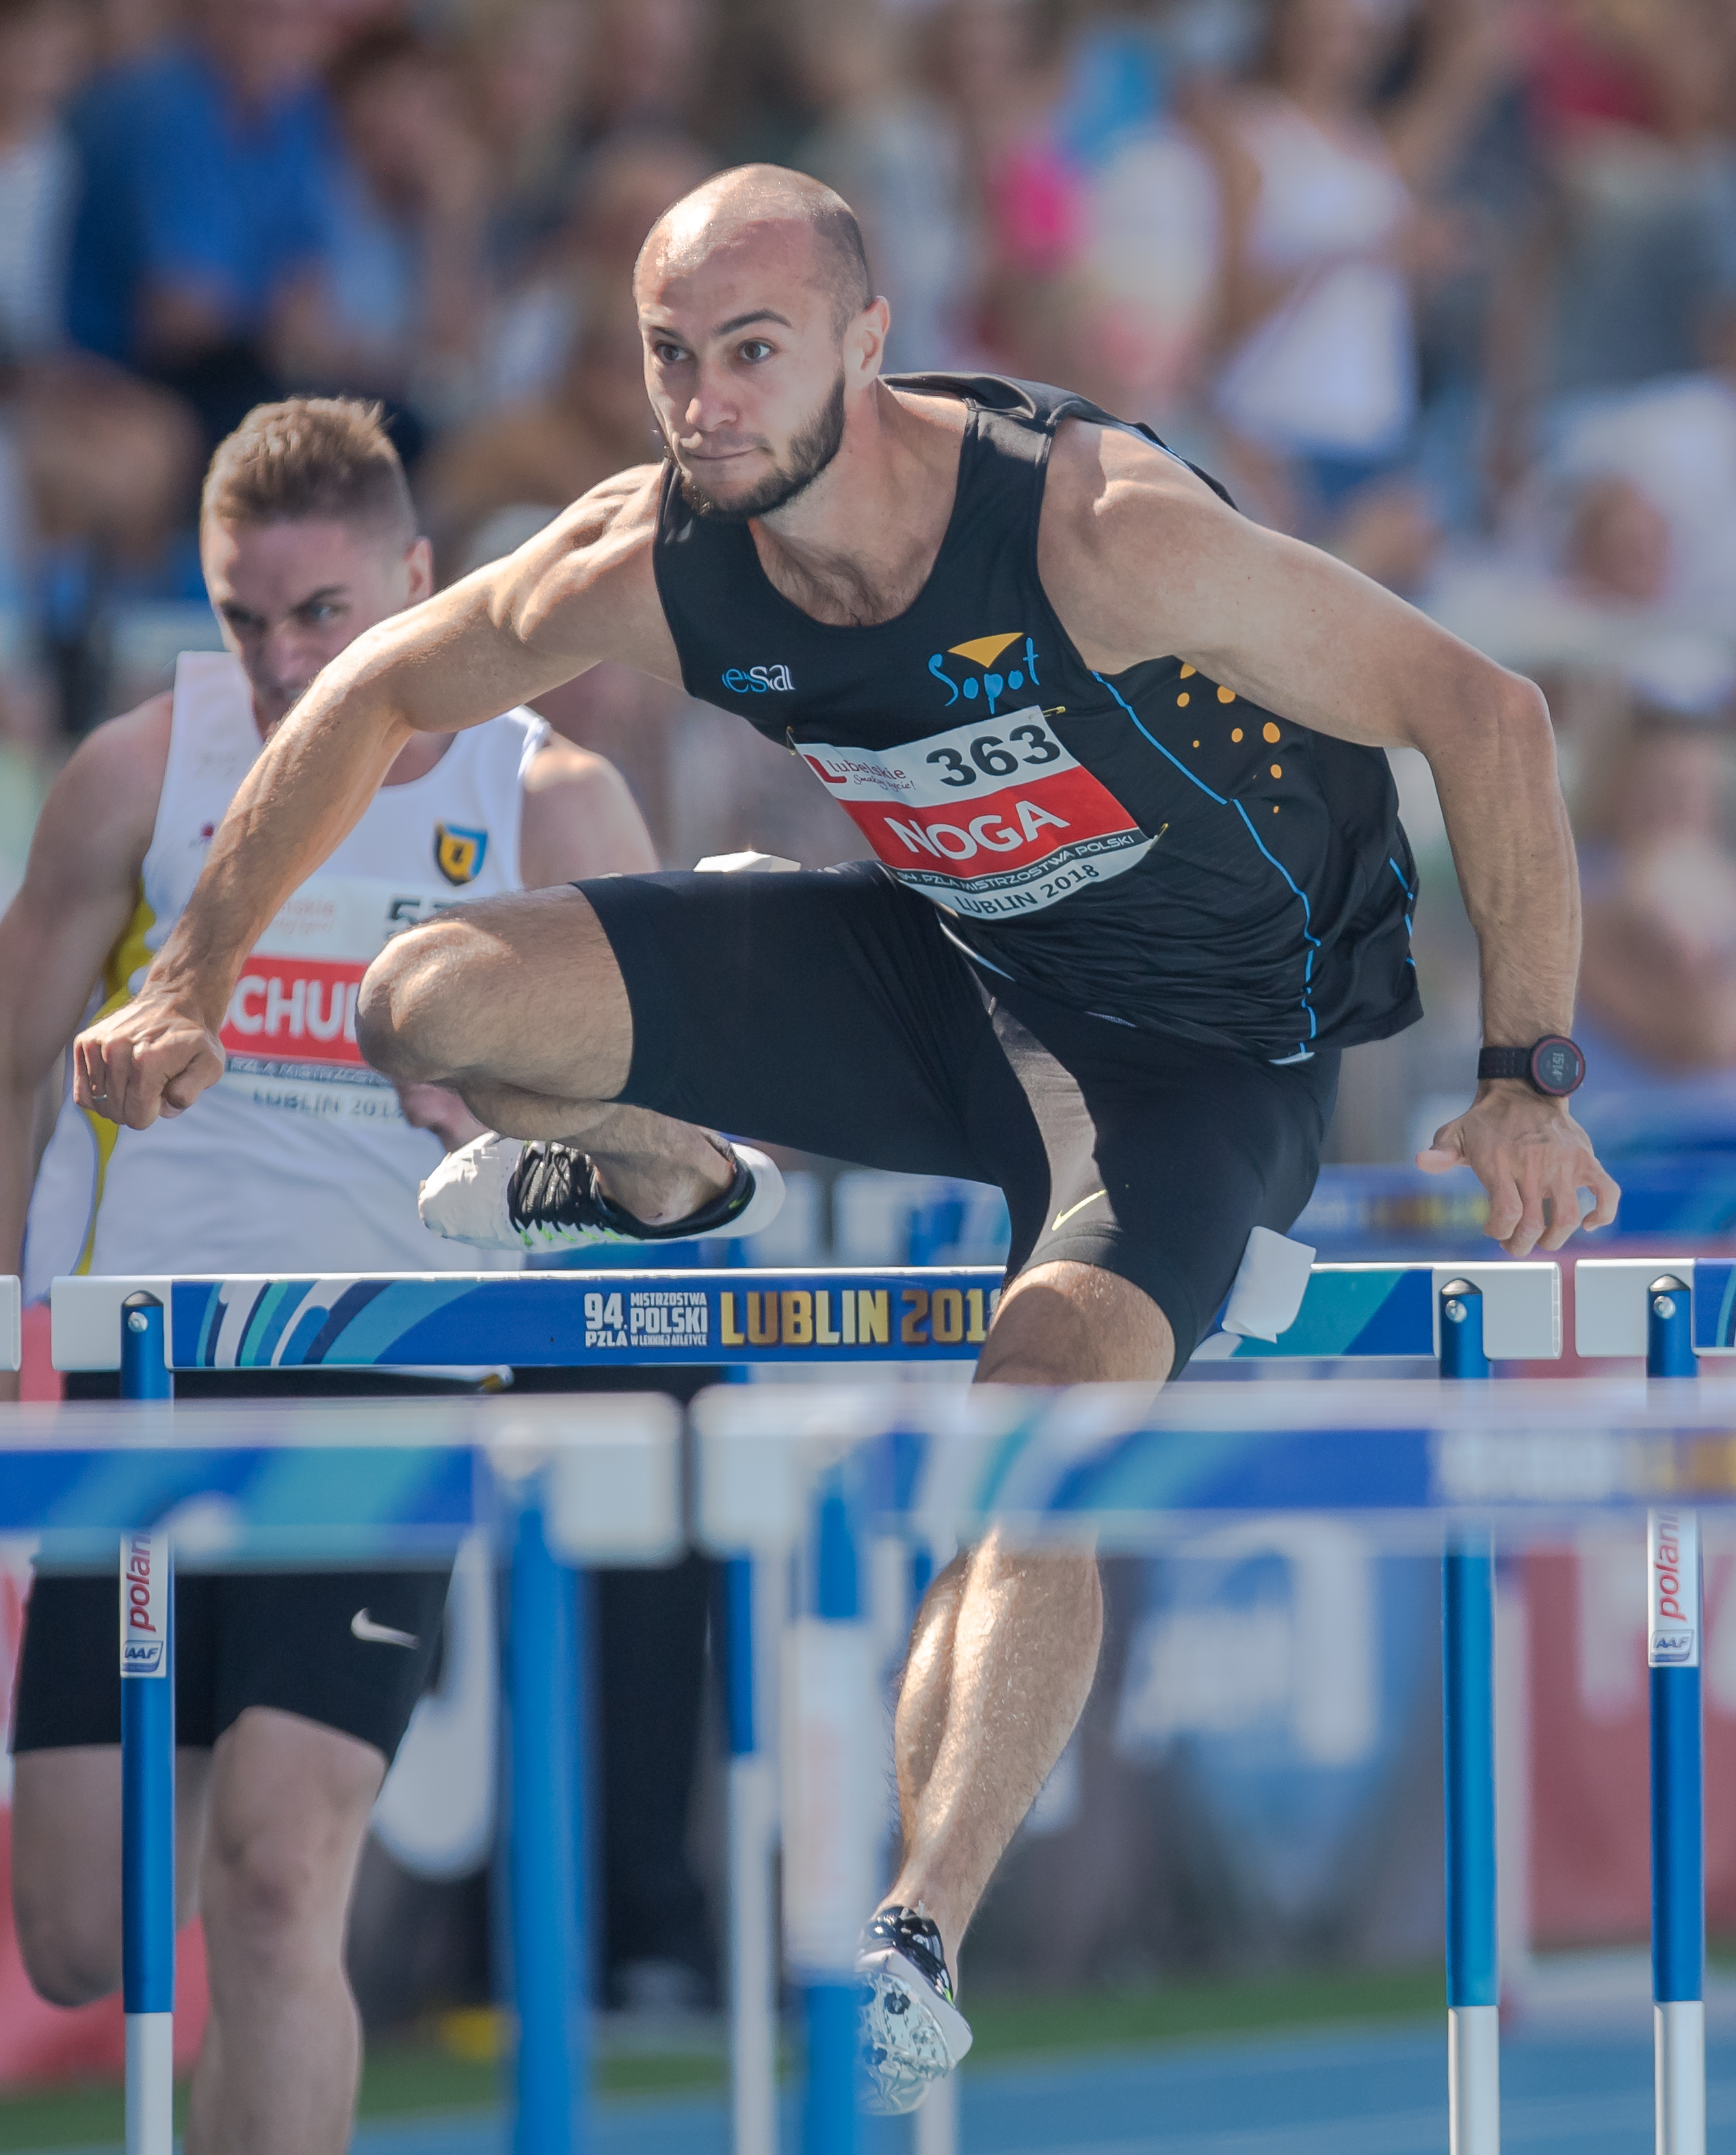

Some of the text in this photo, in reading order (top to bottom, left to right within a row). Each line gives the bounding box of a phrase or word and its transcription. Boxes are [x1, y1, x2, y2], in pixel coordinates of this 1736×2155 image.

[928, 637, 1040, 715] Sopot
[925, 724, 1061, 786] 363
[884, 800, 1070, 860] NOGA
[923, 874, 960, 888] PZLA
[959, 851, 1075, 891] MISTRZOSTWA
[1075, 834, 1135, 856] POLSKI
[954, 864, 1100, 914] LUBLIN 2018
[220, 974, 360, 1044] CHU
[350, 1097, 405, 1120] 201
[584, 1293, 628, 1330] 94.
[630, 1292, 708, 1307] MISTRZOSTWA
[630, 1307, 708, 1334] POLSKI
[720, 1290, 890, 1345] LUBLIN
[586, 1330, 628, 1348] PZLA
[126, 1531, 157, 1632] polan
[124, 1647, 158, 1659] IAAF
